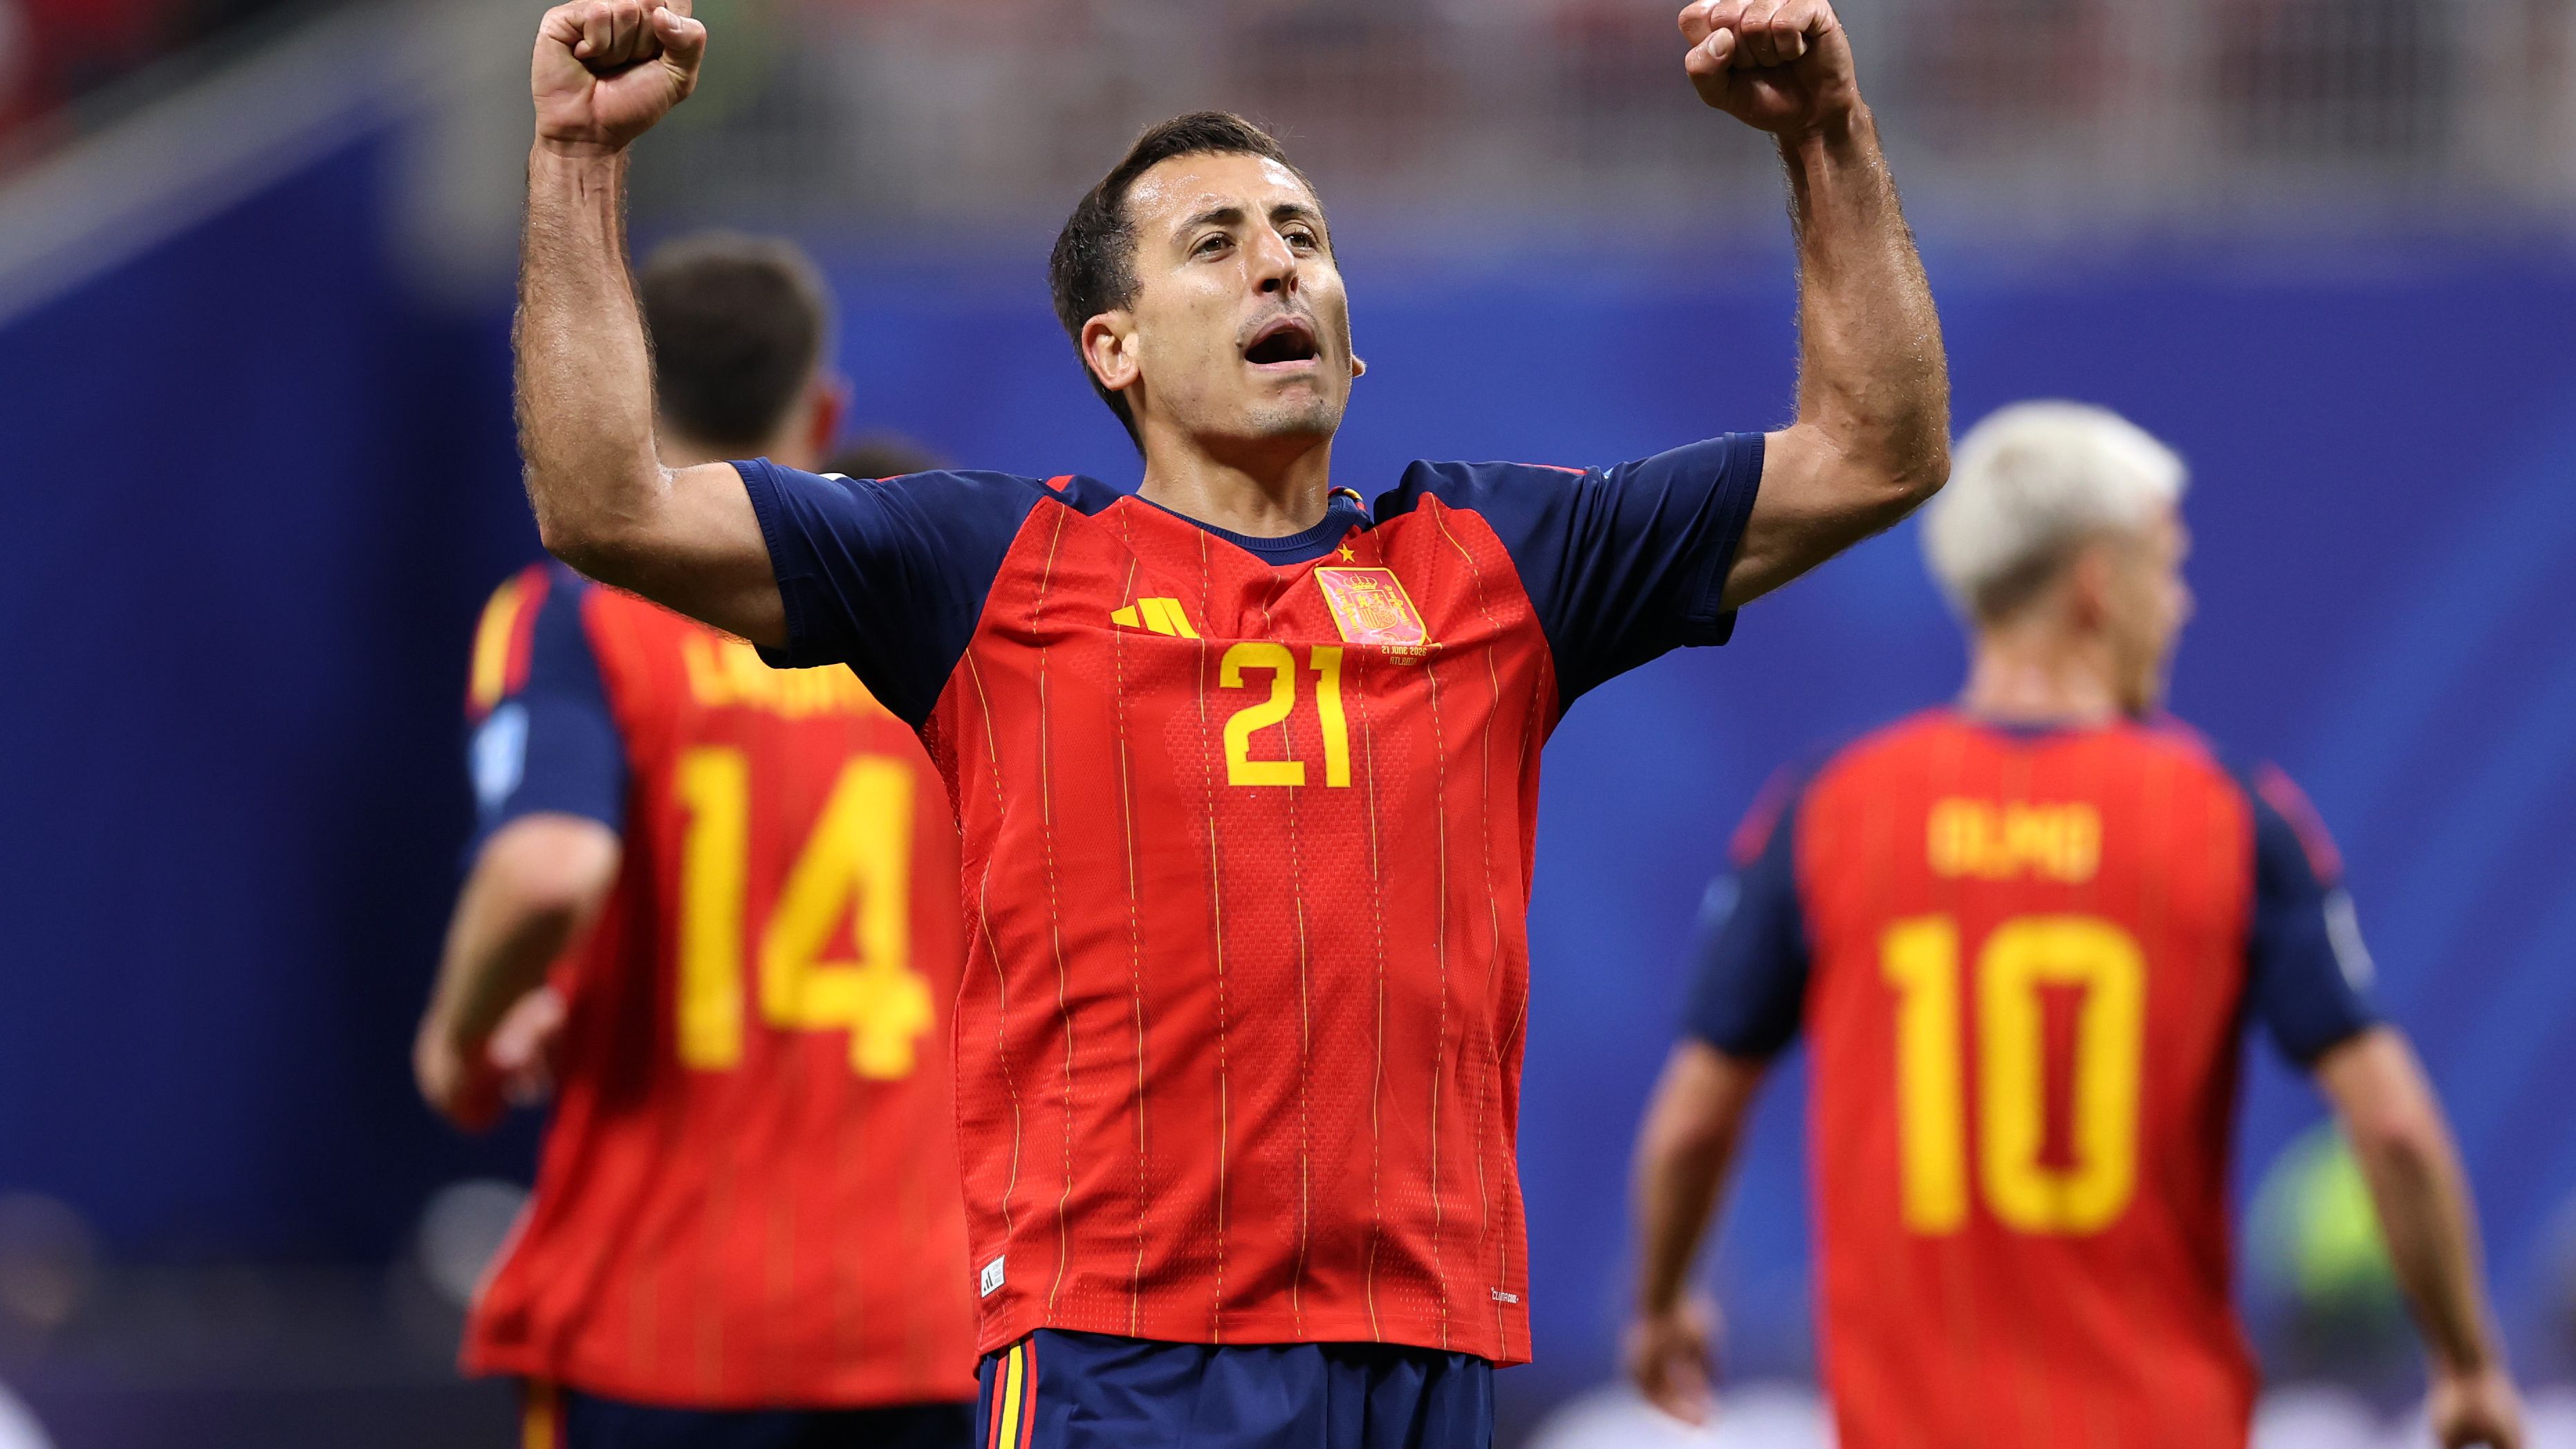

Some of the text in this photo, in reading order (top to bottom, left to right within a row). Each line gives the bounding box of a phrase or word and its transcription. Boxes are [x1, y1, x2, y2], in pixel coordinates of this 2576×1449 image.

[1219, 642, 1351, 788] 21
[1381, 645, 1427, 656] 21 JUNE 2026
[678, 745, 933, 1079] 14
[1881, 915, 2147, 1236] 10
